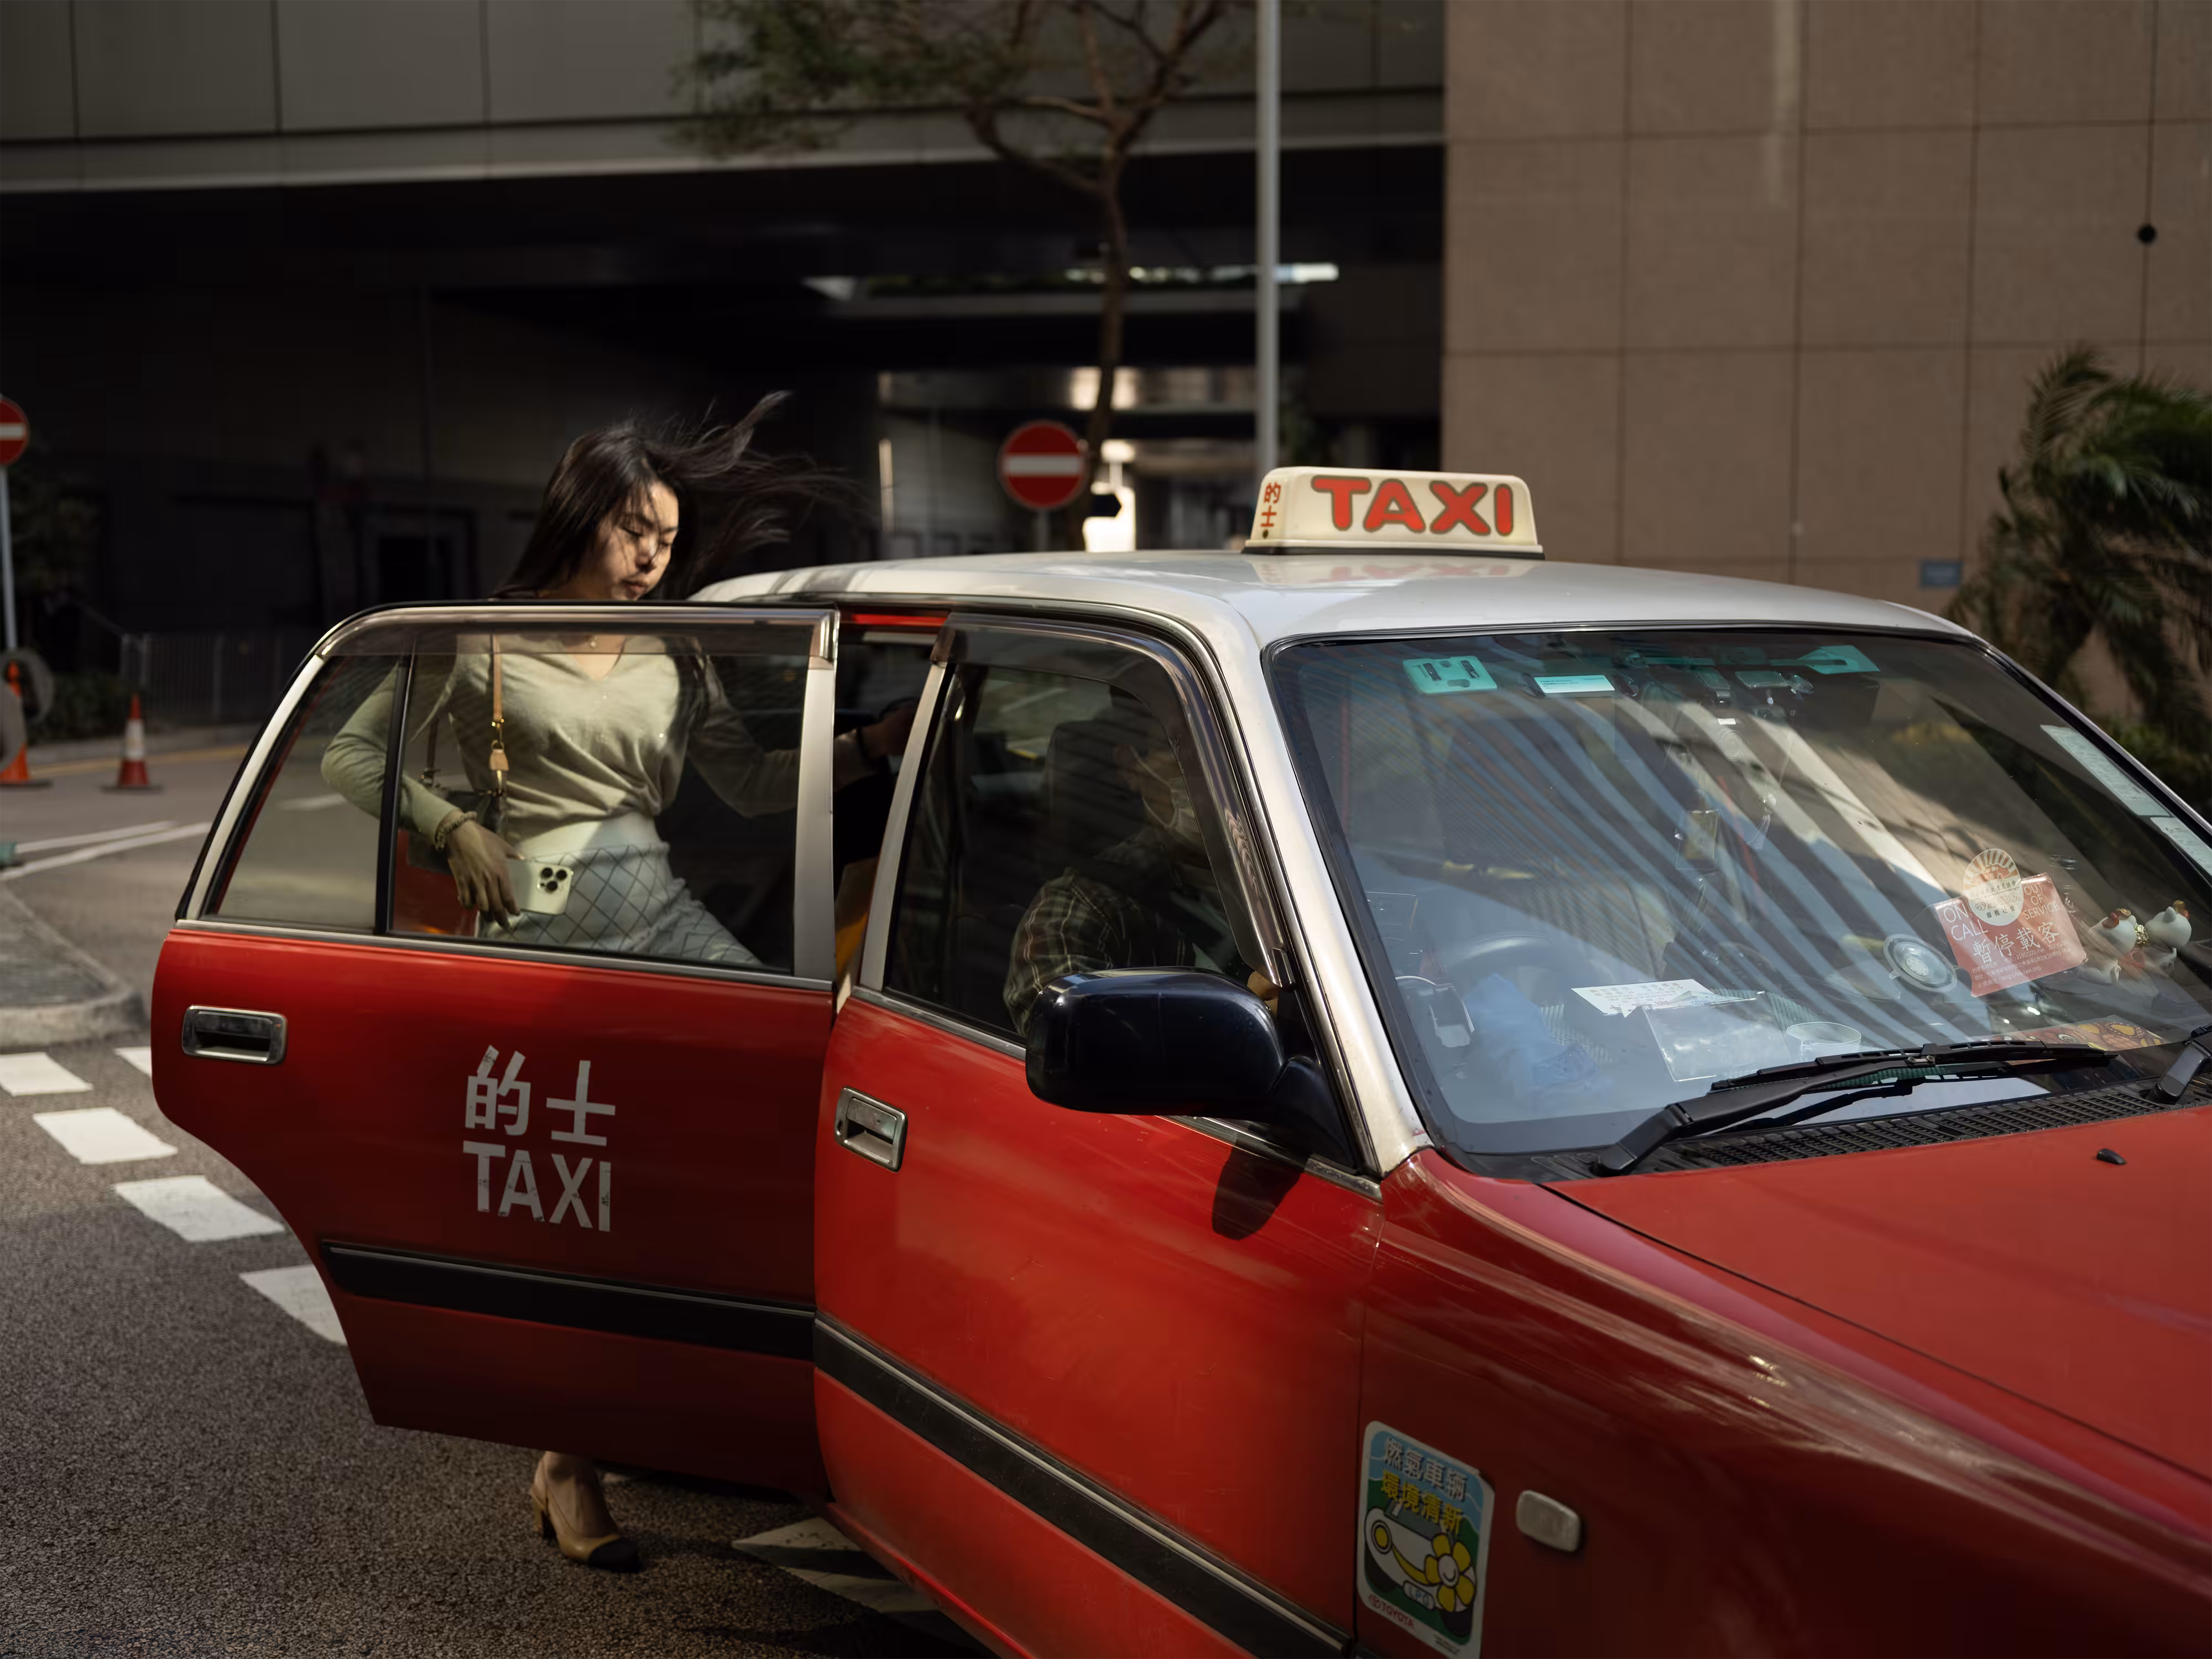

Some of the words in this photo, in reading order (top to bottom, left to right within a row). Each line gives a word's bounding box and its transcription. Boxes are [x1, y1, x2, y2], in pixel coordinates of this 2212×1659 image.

[1260, 482, 1281, 528] 的士
[1311, 474, 1514, 536] TAXI
[2023, 884, 2043, 895] OUT
[2031, 894, 2044, 905] OF
[1943, 905, 1969, 923] ON
[2023, 902, 2060, 920] SERVICE
[1951, 919, 1989, 941] CALL
[1972, 921, 2061, 964] 暫停載客
[465, 1045, 616, 1146] 的士
[463, 1140, 611, 1232] TAXI
[1381, 1469, 1462, 1535] 環境清新
[1383, 1603, 1415, 1630] TOYOTA
